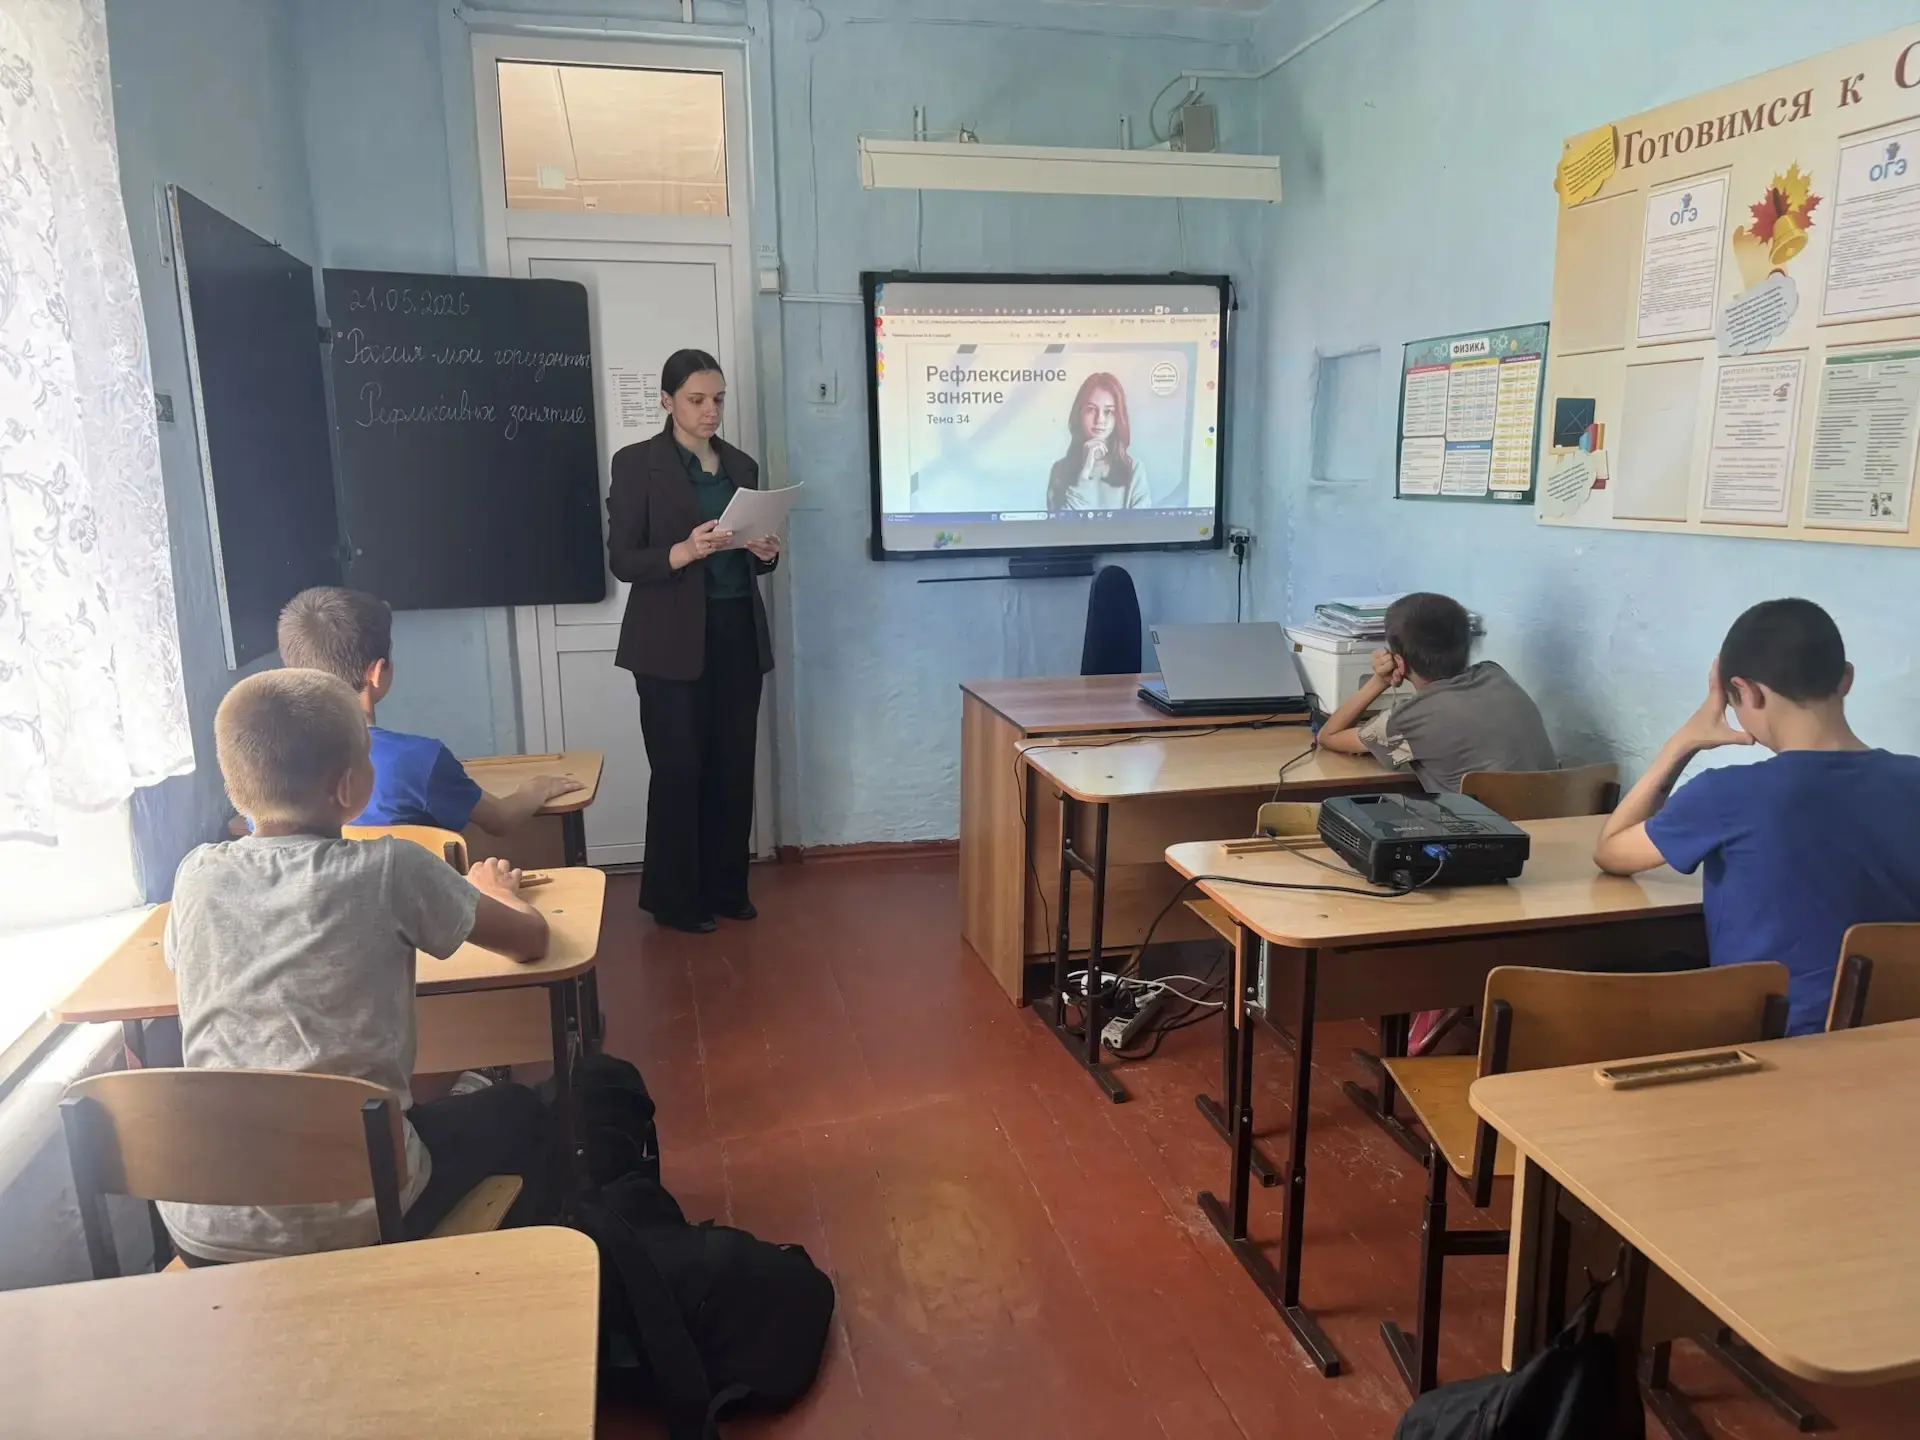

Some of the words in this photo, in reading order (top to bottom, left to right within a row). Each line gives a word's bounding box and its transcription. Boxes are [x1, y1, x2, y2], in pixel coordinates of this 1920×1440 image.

[1621, 88, 1815, 170] Готовимся
[1869, 158, 1907, 181] ОГЭ
[1670, 207, 1697, 226] ОГЭ
[349, 286, 470, 316] 21.05.2026
[1453, 341, 1486, 354] ФИЗИКА
[494, 349, 591, 382] горизонты
[926, 365, 1067, 387] Рефлексивное
[926, 391, 1004, 404] занятие
[505, 405, 587, 439] занятие
[926, 414, 954, 425] Тема
[956, 414, 970, 424] 34
